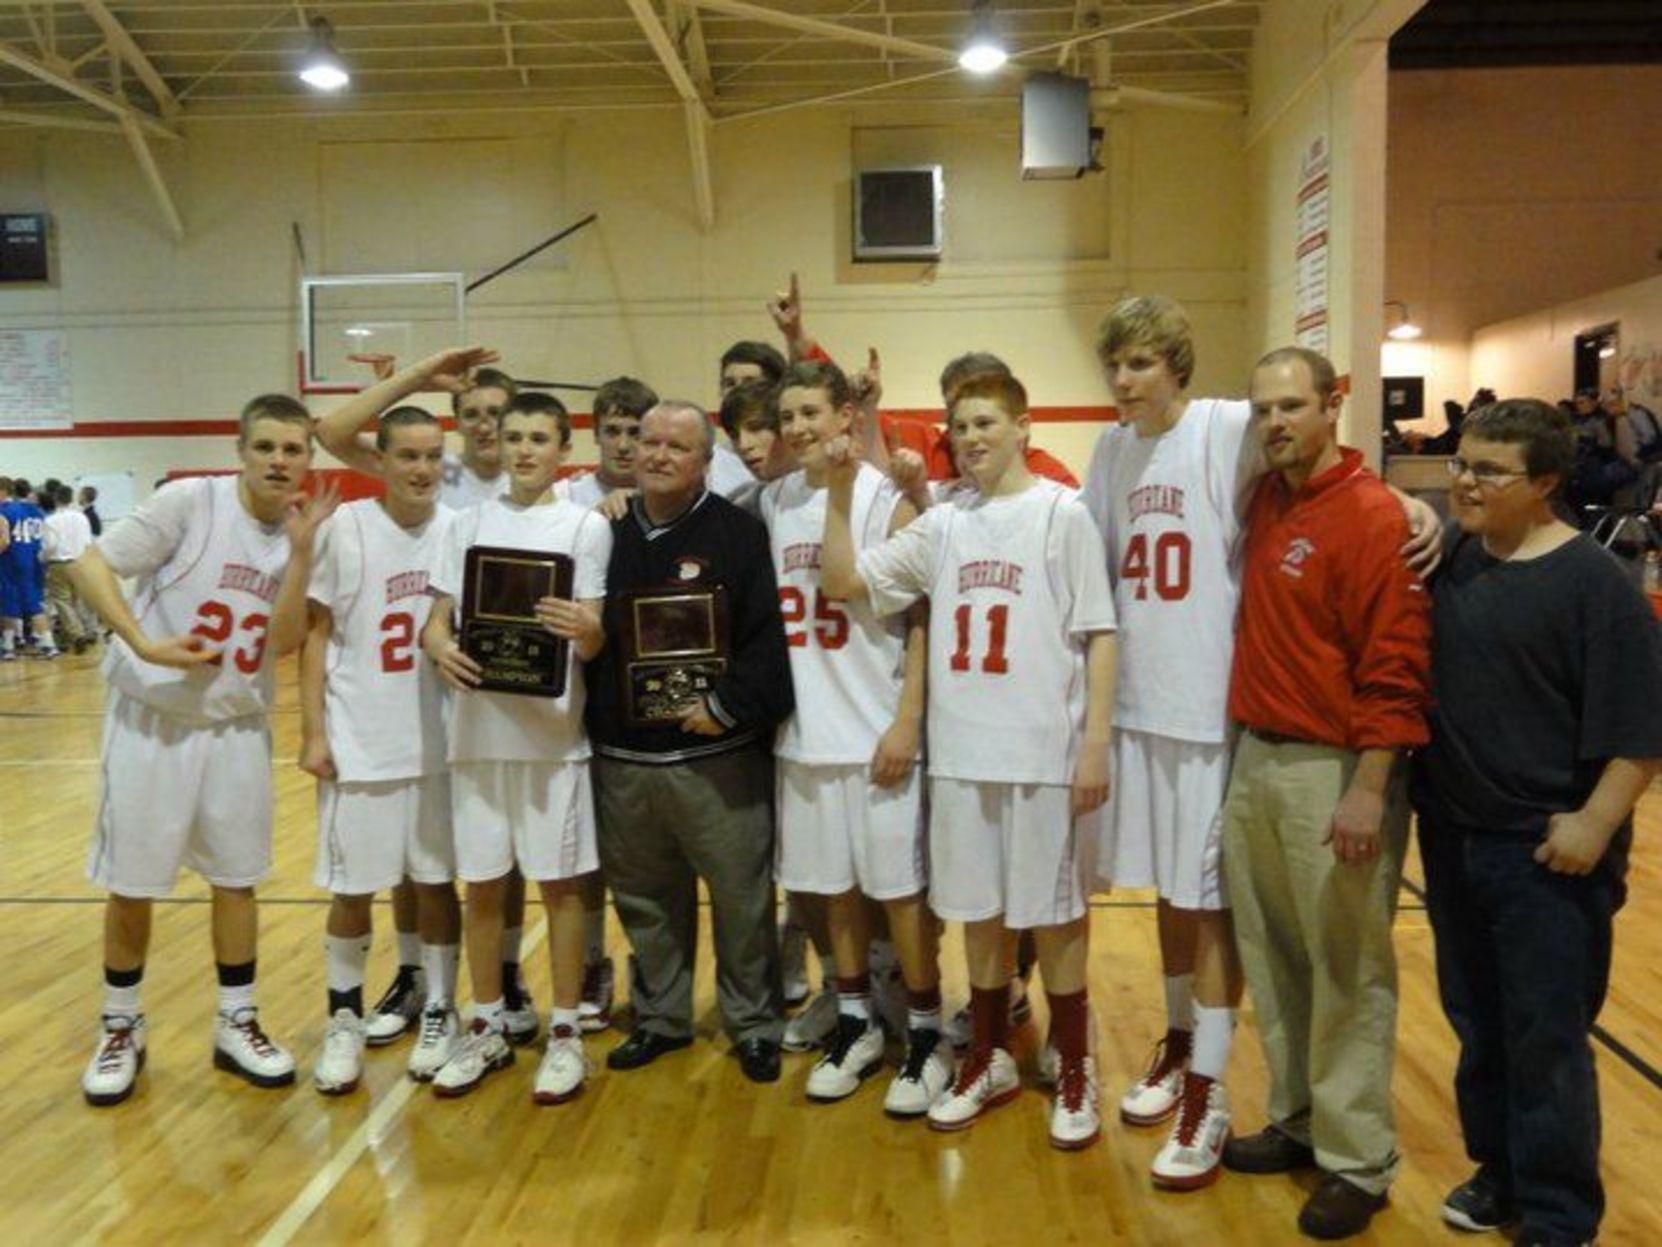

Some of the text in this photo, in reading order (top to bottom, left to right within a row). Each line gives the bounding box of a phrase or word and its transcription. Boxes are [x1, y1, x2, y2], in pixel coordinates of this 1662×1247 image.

[958, 560, 1024, 595] HURRICANE
[1120, 531, 1191, 601] 40
[189, 600, 270, 675] 23
[380, 611, 415, 673] 2
[777, 586, 850, 650] 25
[950, 604, 1009, 674] 11
